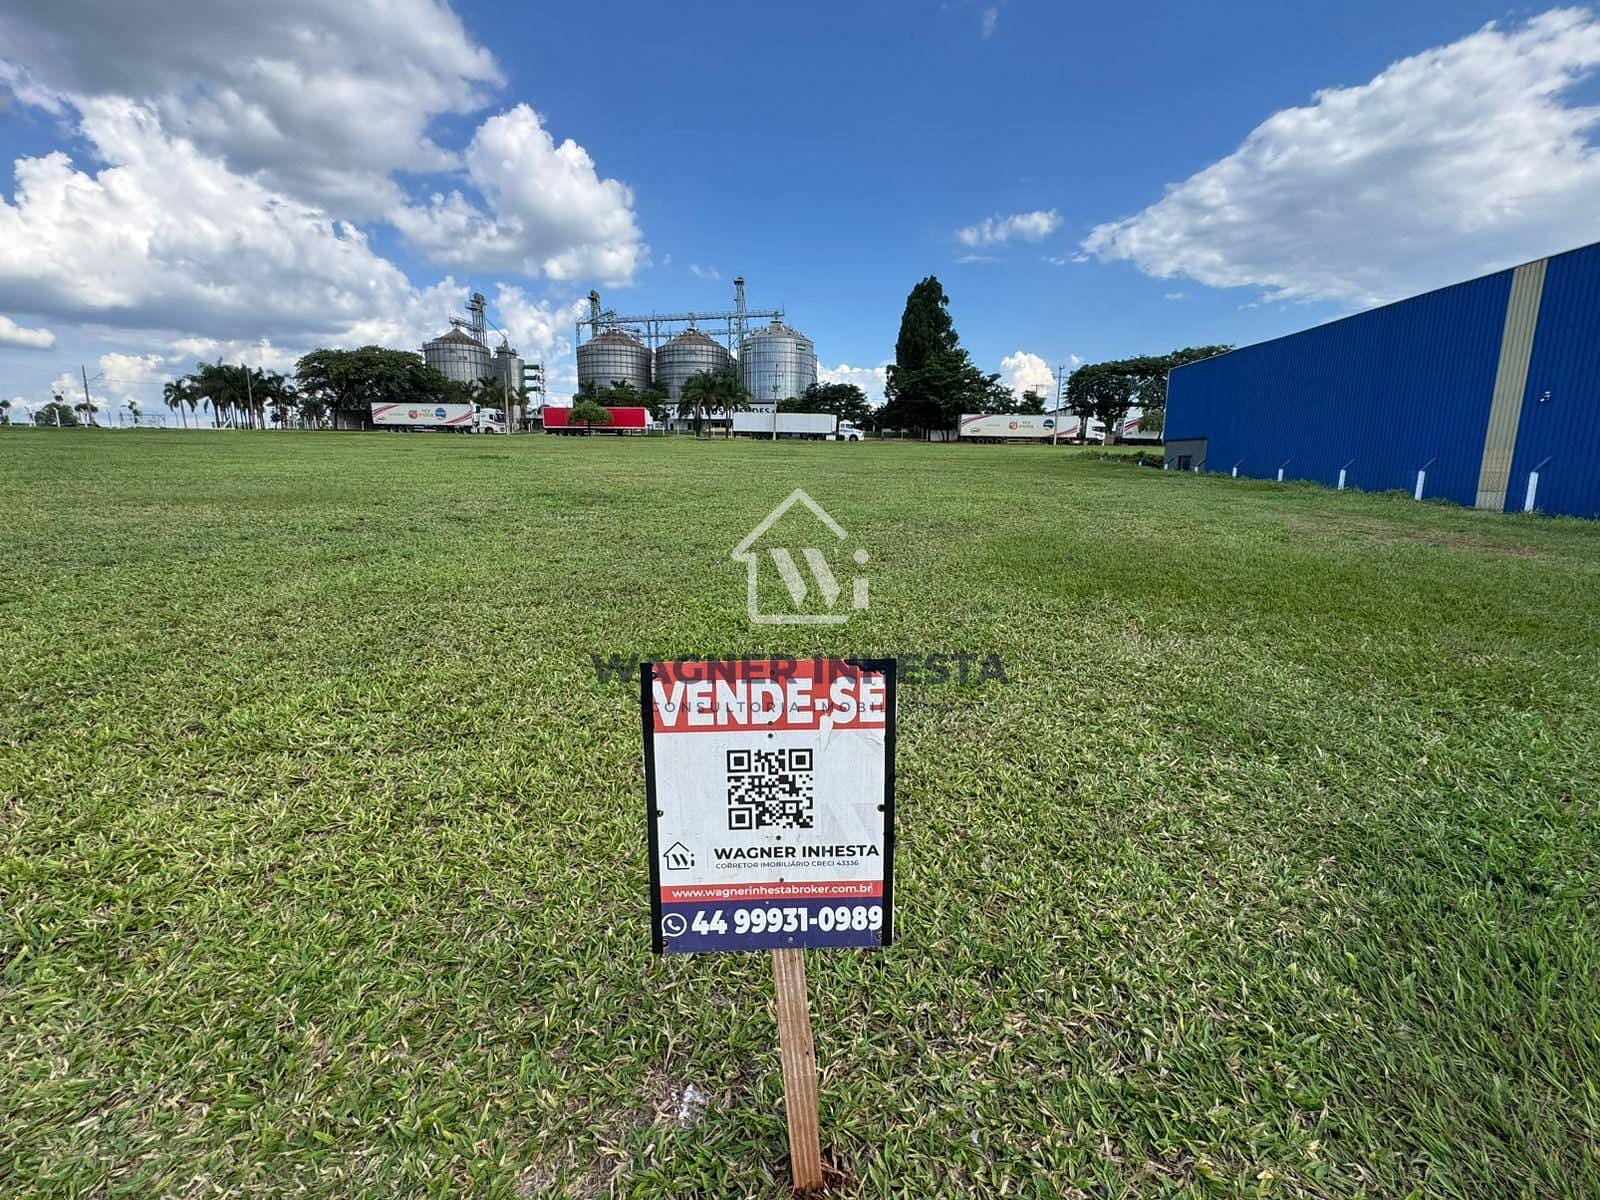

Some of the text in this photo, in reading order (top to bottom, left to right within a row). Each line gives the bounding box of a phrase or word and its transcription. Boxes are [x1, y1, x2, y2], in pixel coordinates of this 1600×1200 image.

[652, 675, 886, 727] VENDE-SE
[714, 844, 880, 860] WAGNER INHESTA
[715, 859, 860, 870] CORRETOR IMOBILIÁRIO CRECI 43336
[672, 883, 873, 899] www.wagnerinhestabroker.com.br
[691, 905, 883, 936] 44 99931-0989
